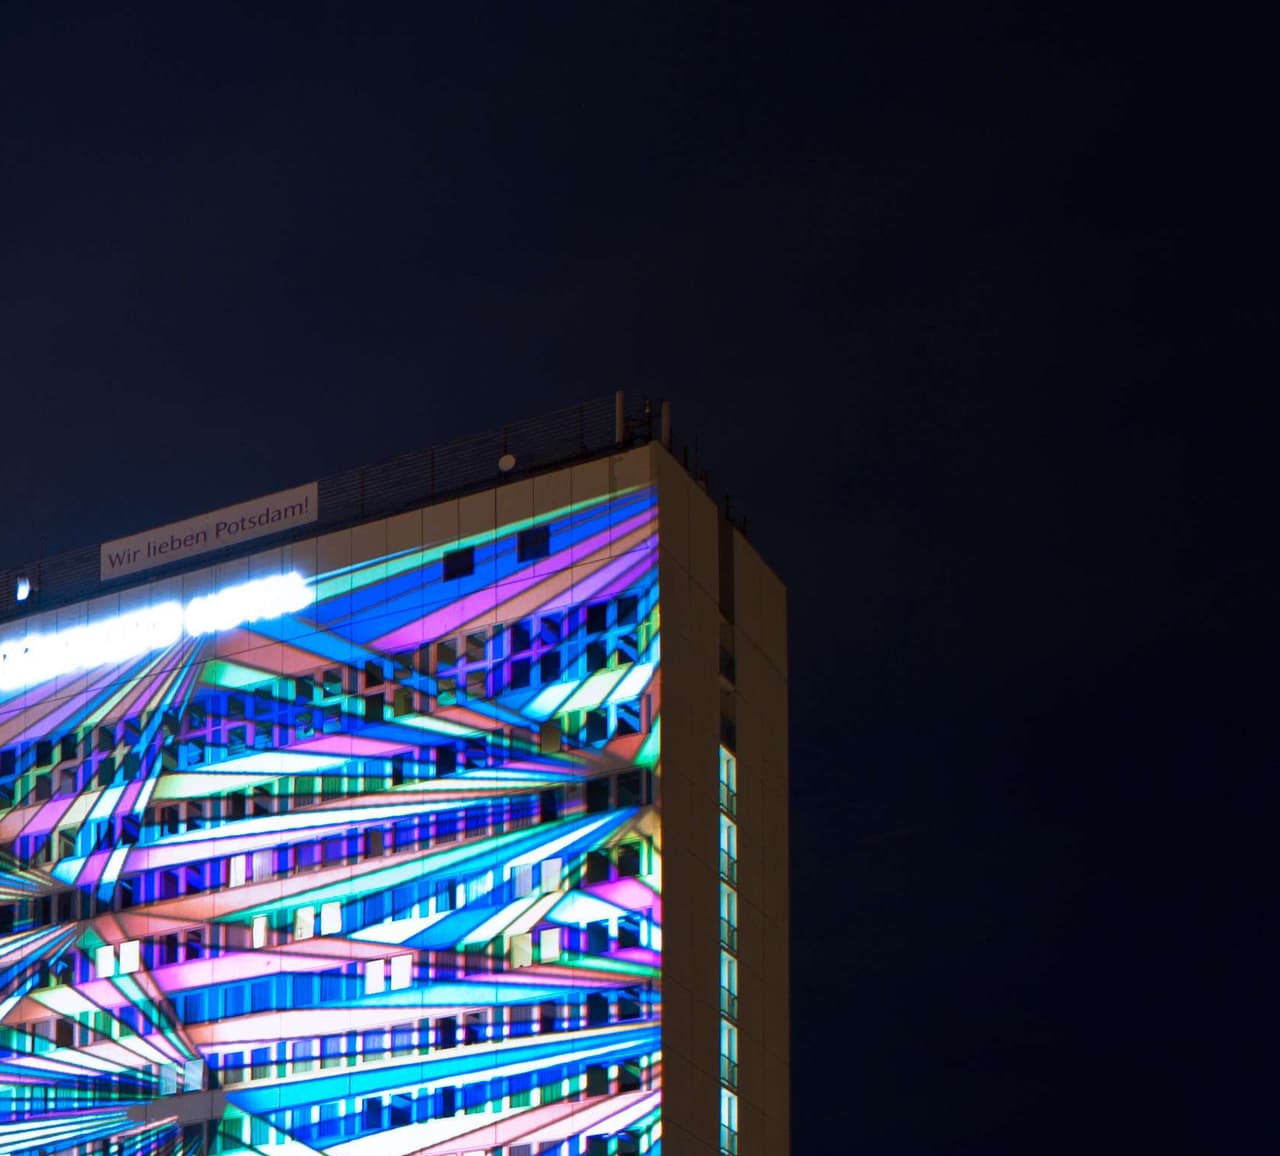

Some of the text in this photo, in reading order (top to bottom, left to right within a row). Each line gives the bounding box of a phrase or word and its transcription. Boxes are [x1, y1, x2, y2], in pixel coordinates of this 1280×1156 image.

[108, 495, 309, 569] Wir lieben Potsdam!
